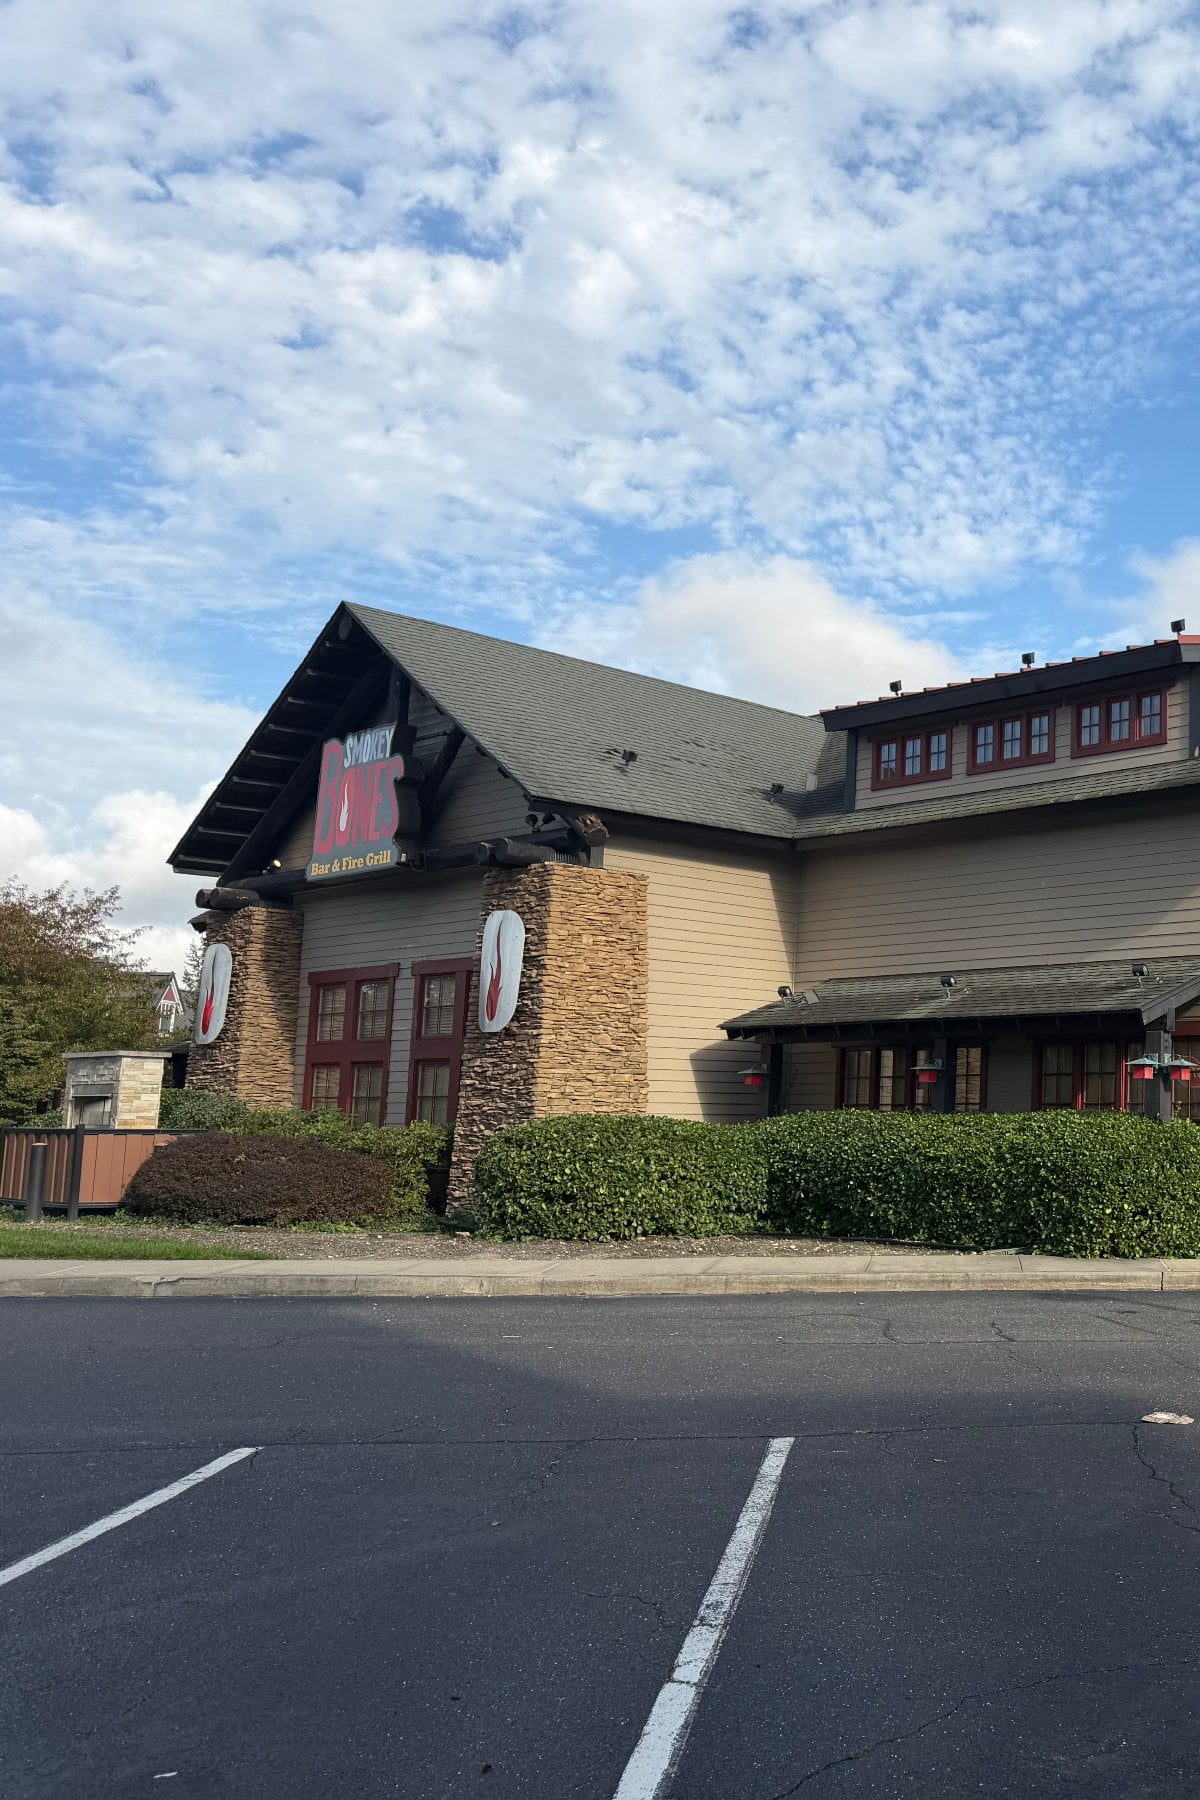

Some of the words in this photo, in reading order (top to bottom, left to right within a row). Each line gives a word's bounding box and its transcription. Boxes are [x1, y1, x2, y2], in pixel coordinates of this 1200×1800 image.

[344, 727, 396, 768] SMOKEY
[315, 743, 403, 854] BONES
[311, 862, 330, 876] Bar
[331, 860, 341, 873] &
[341, 855, 364, 871] Fire
[366, 849, 391, 867] Grill
